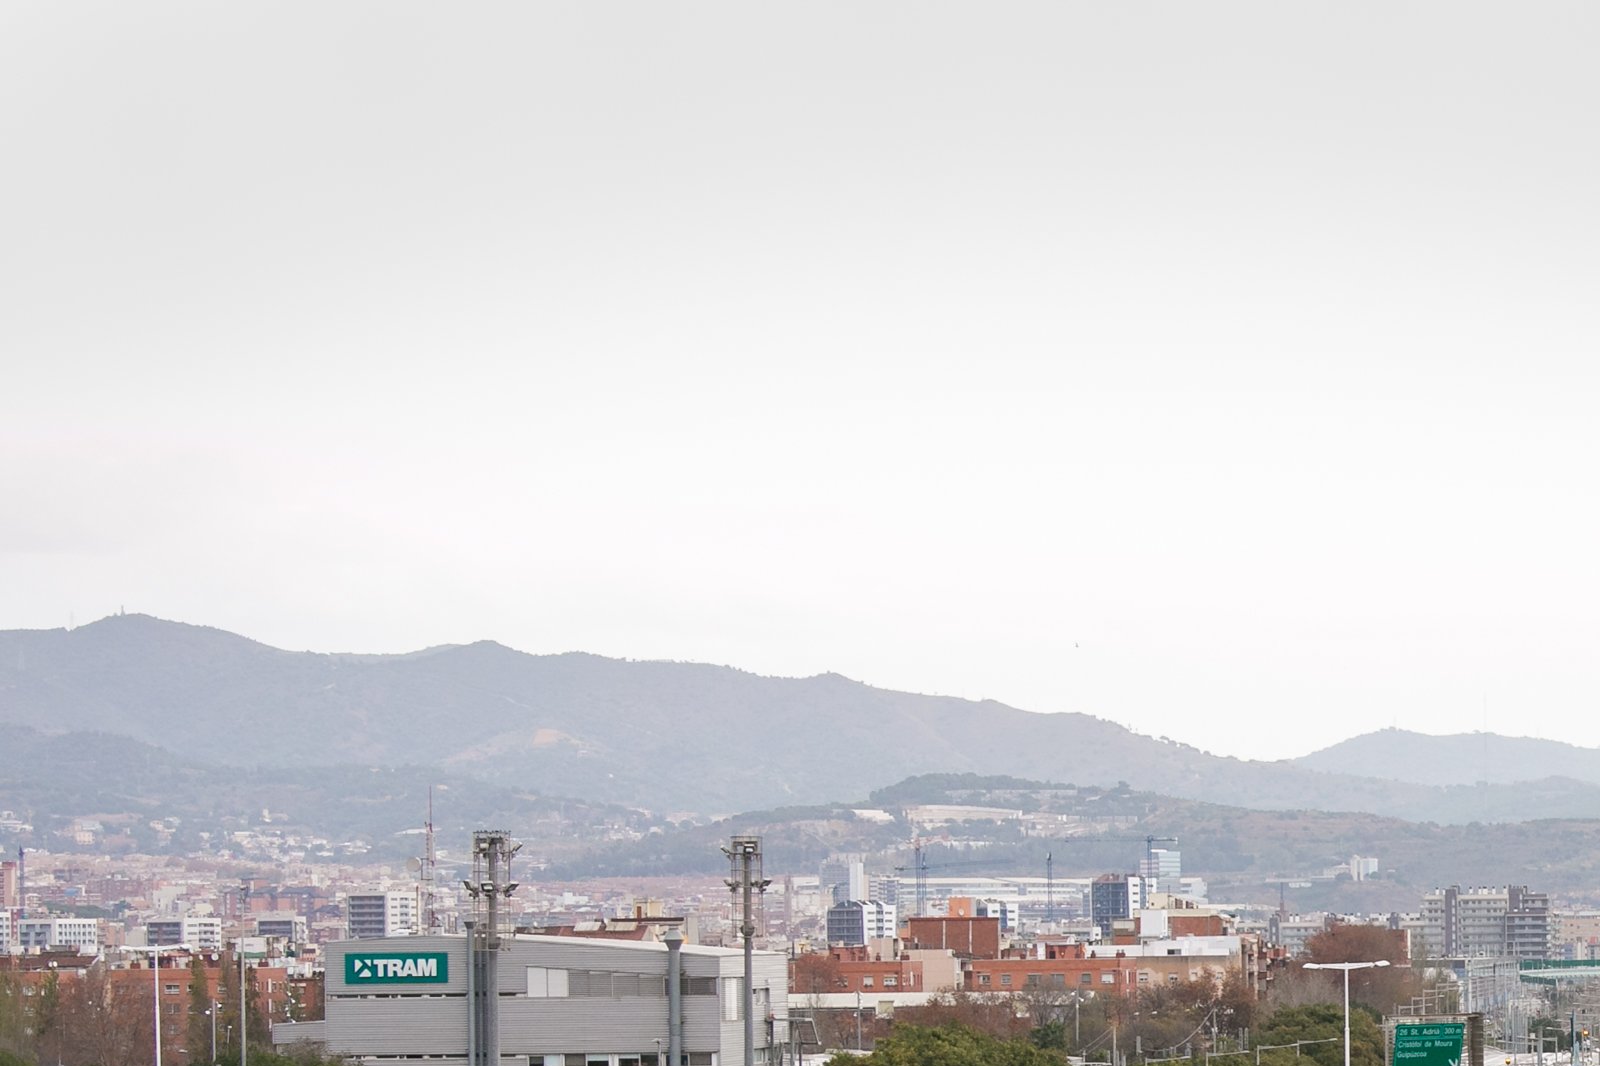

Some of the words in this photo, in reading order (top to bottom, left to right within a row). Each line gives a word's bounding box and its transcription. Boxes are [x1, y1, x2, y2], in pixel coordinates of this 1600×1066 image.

[373, 958, 437, 977] TRAM
[1399, 1028, 1408, 1036] 26
[1444, 1027, 1455, 1035] 300
[1434, 1039, 1453, 1047] Moura
